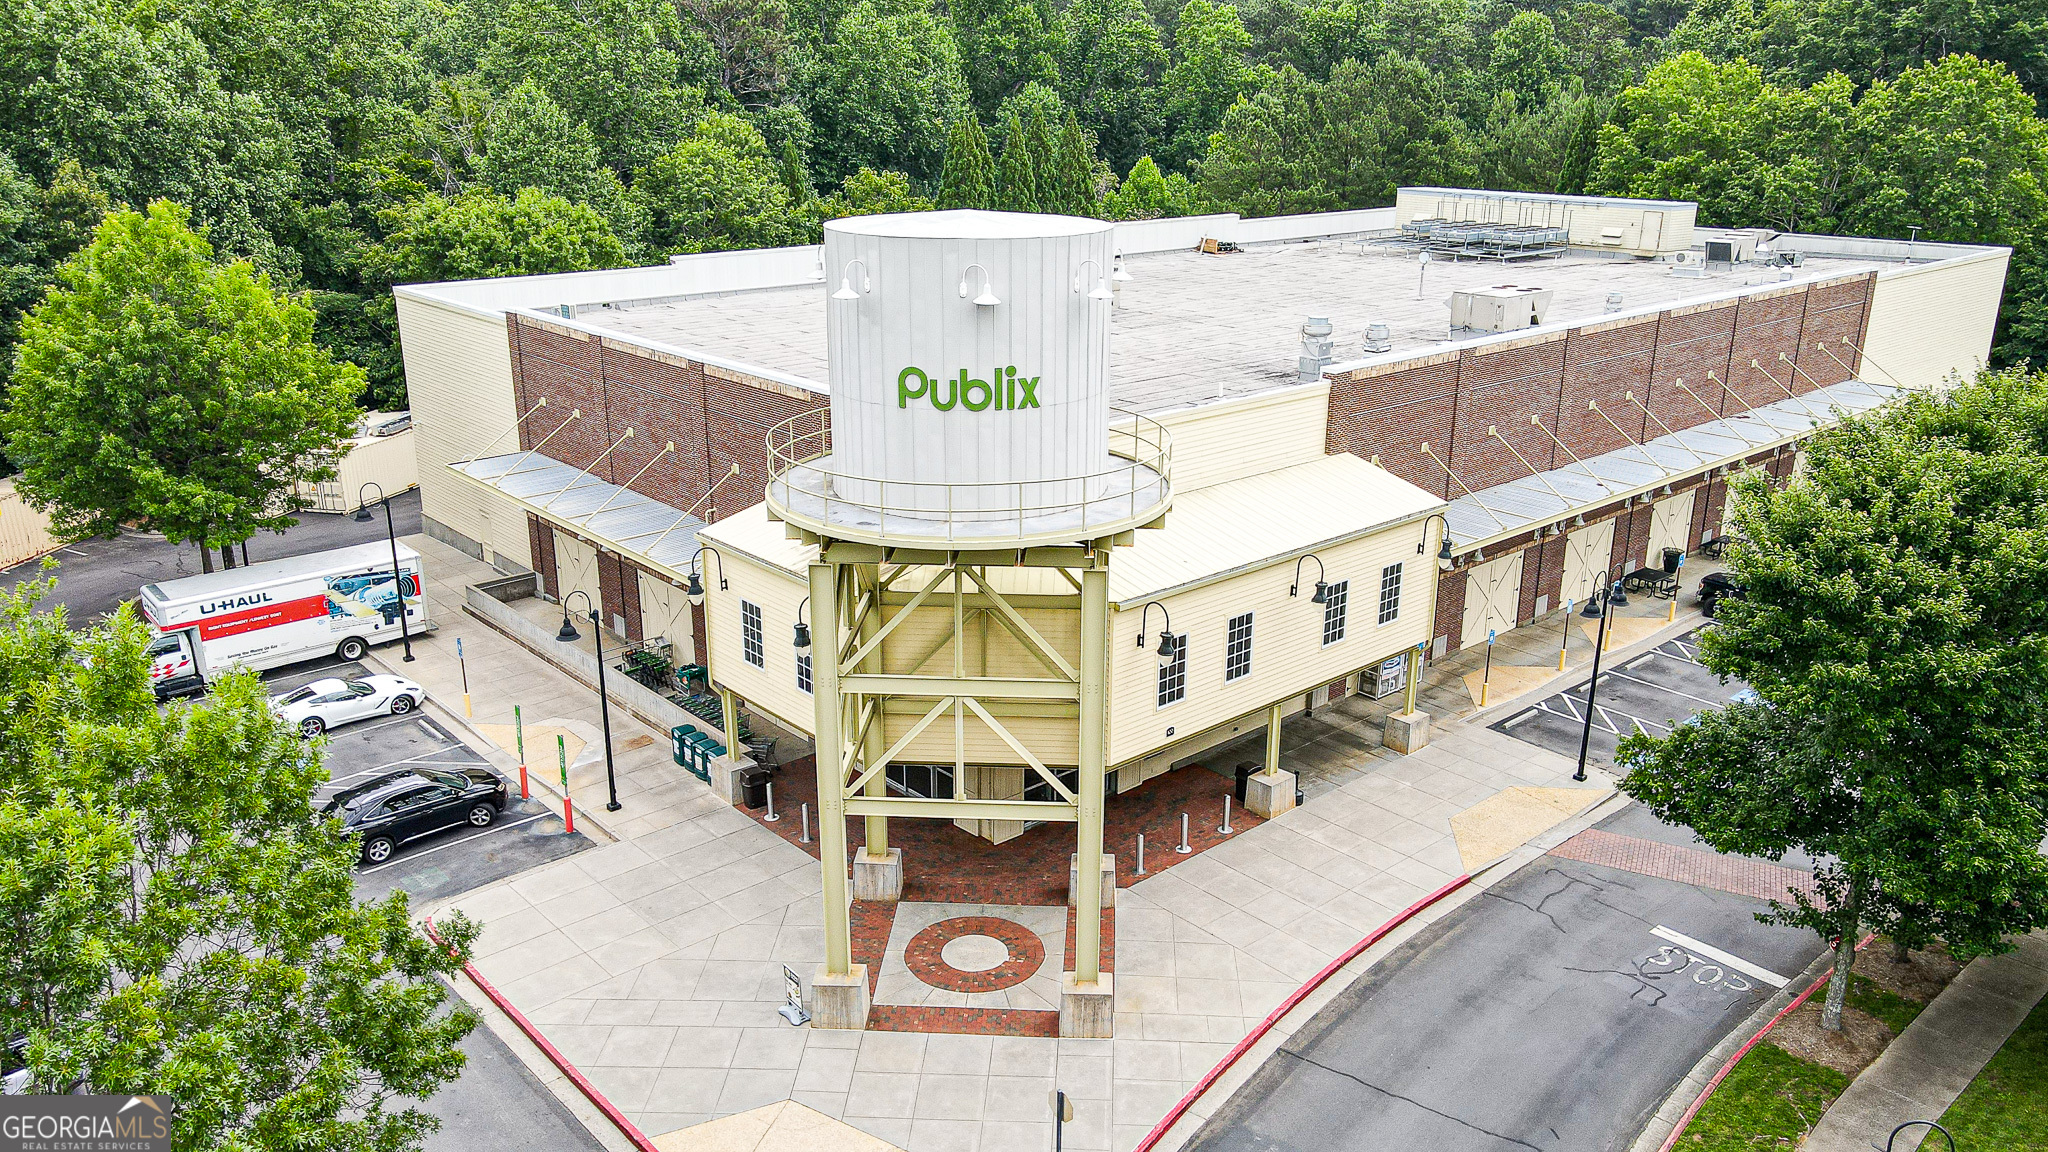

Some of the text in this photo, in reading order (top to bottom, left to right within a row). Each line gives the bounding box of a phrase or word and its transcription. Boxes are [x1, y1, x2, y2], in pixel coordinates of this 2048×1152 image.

[898, 365, 1041, 412] Publix
[200, 592, 273, 614] U-HAUL
[1648, 946, 1751, 991] STOP
